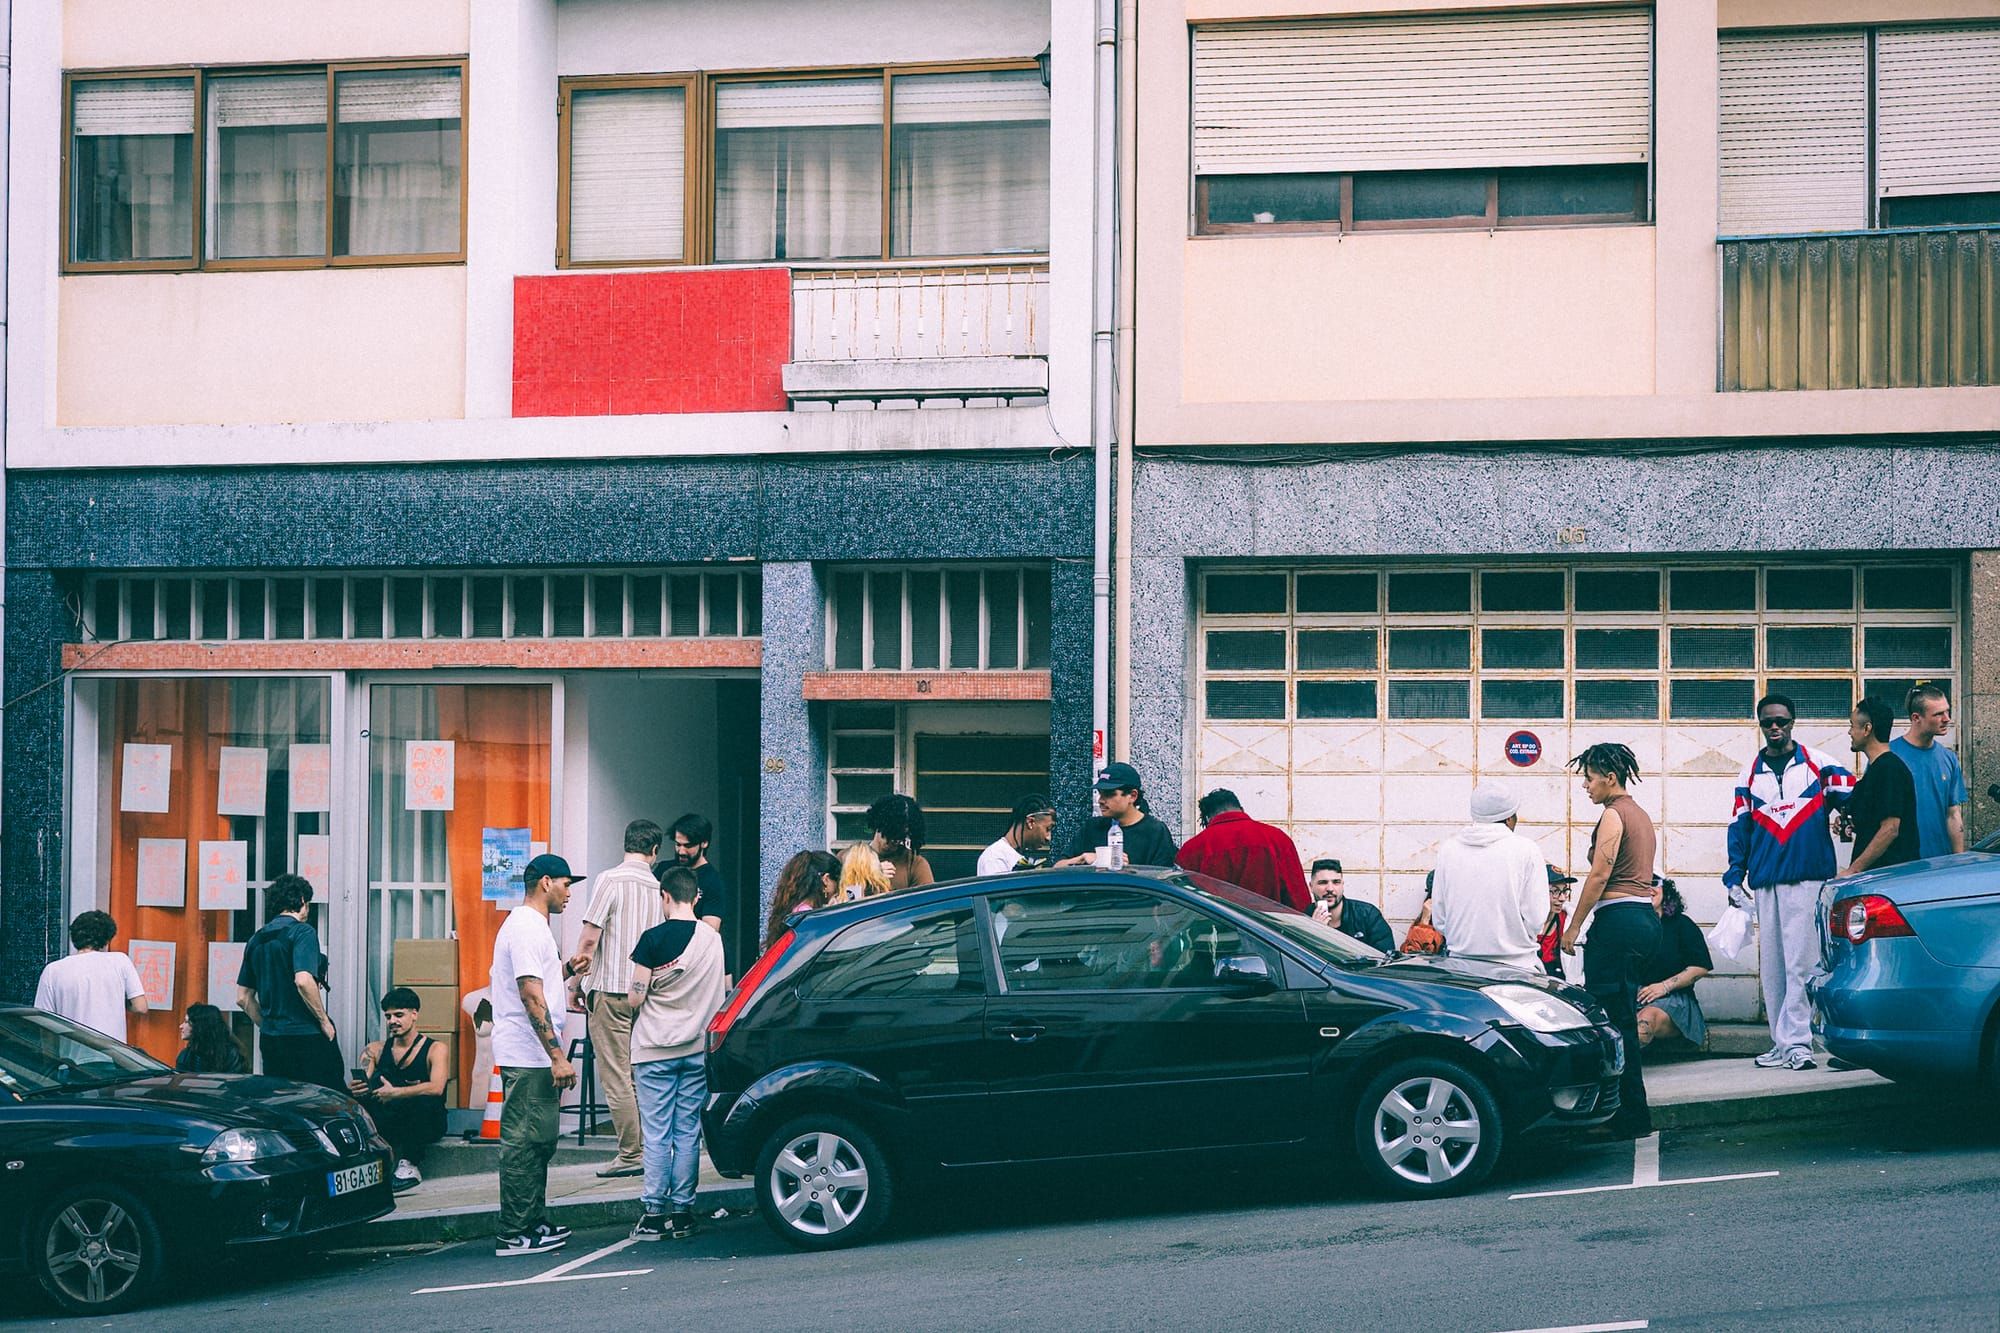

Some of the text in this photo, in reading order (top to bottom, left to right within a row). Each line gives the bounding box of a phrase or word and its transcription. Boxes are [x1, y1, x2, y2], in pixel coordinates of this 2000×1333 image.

[1556, 527, 1585, 544] 105
[917, 680, 931, 693] 101
[765, 758, 784, 773] 99
[1770, 802, 1796, 813] hummel
